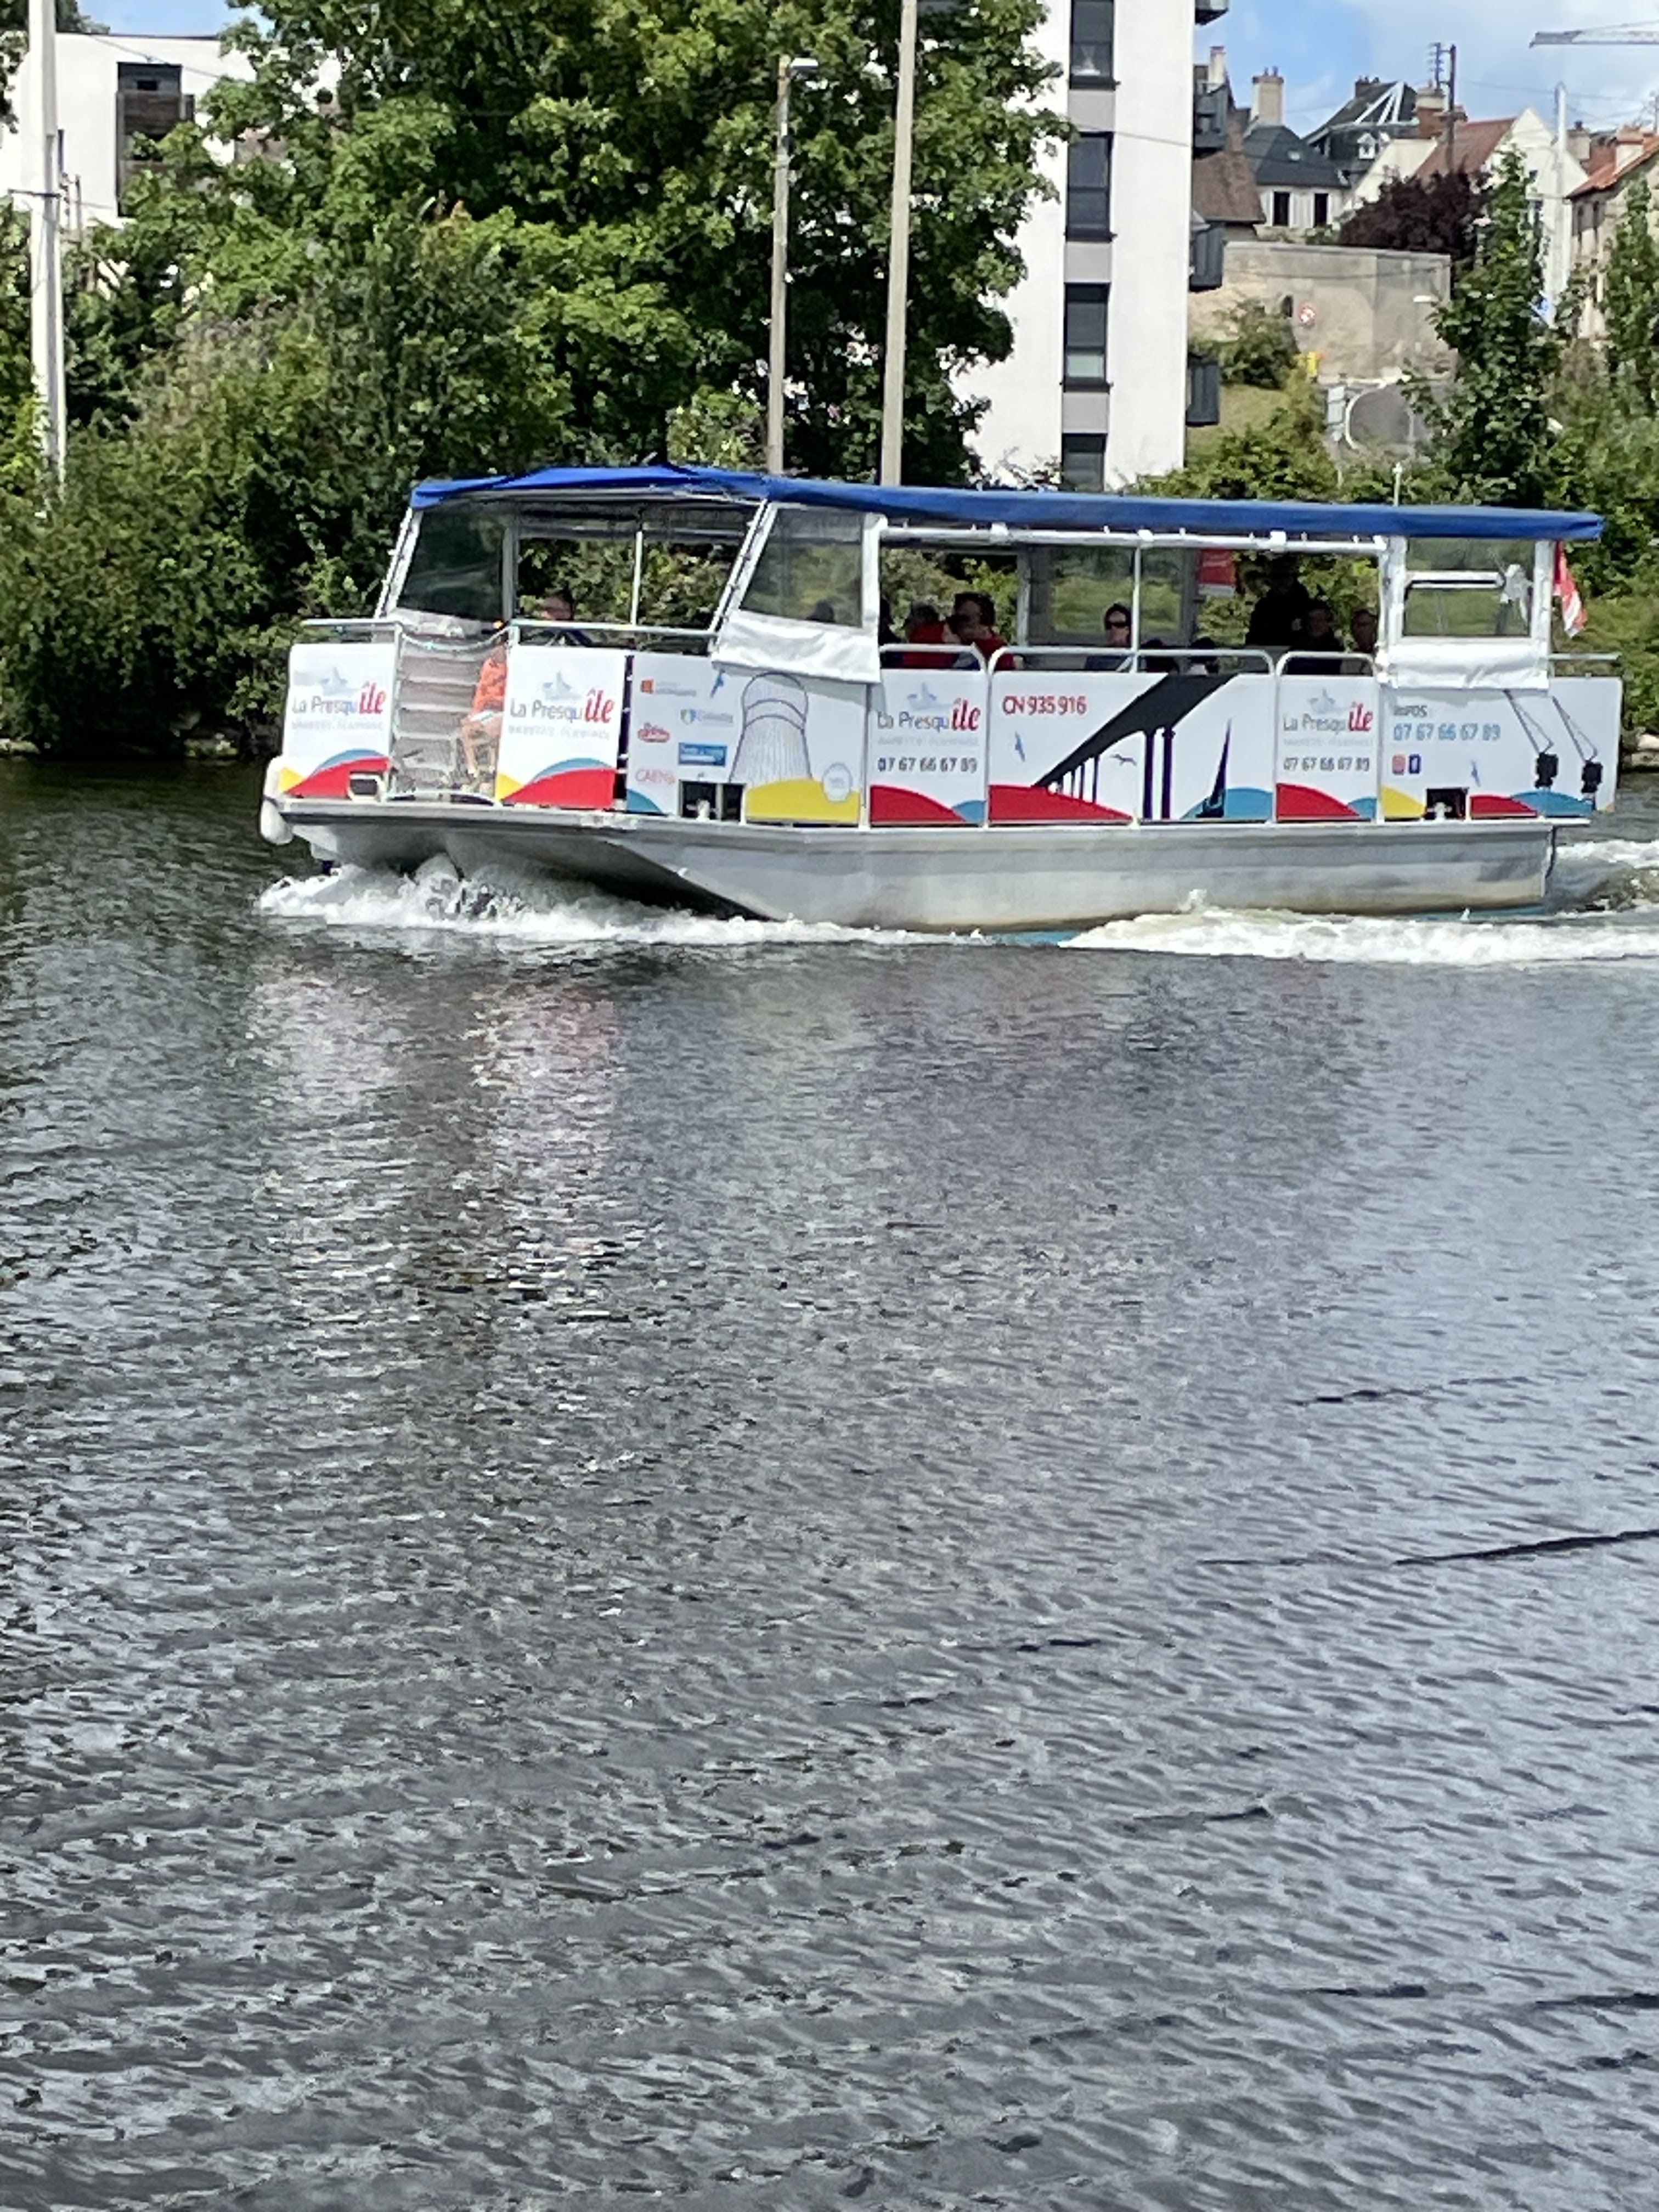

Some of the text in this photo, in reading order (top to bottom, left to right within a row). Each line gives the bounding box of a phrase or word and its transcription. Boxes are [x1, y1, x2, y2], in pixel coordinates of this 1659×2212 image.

[291, 696, 307, 713] La
[510, 697, 526, 718] La
[1003, 696, 1087, 715] CN 935 916
[1283, 712, 1298, 731] La
[1393, 723, 1412, 741] 07
[1416, 723, 1434, 741] 67
[1438, 723, 1456, 741] 66
[1460, 723, 1478, 741] 67
[878, 757, 895, 772] 07
[899, 757, 916, 772] 67
[919, 757, 936, 772] 66
[940, 757, 957, 772] 67
[1283, 757, 1299, 771] 07
[1302, 757, 1317, 771] 67
